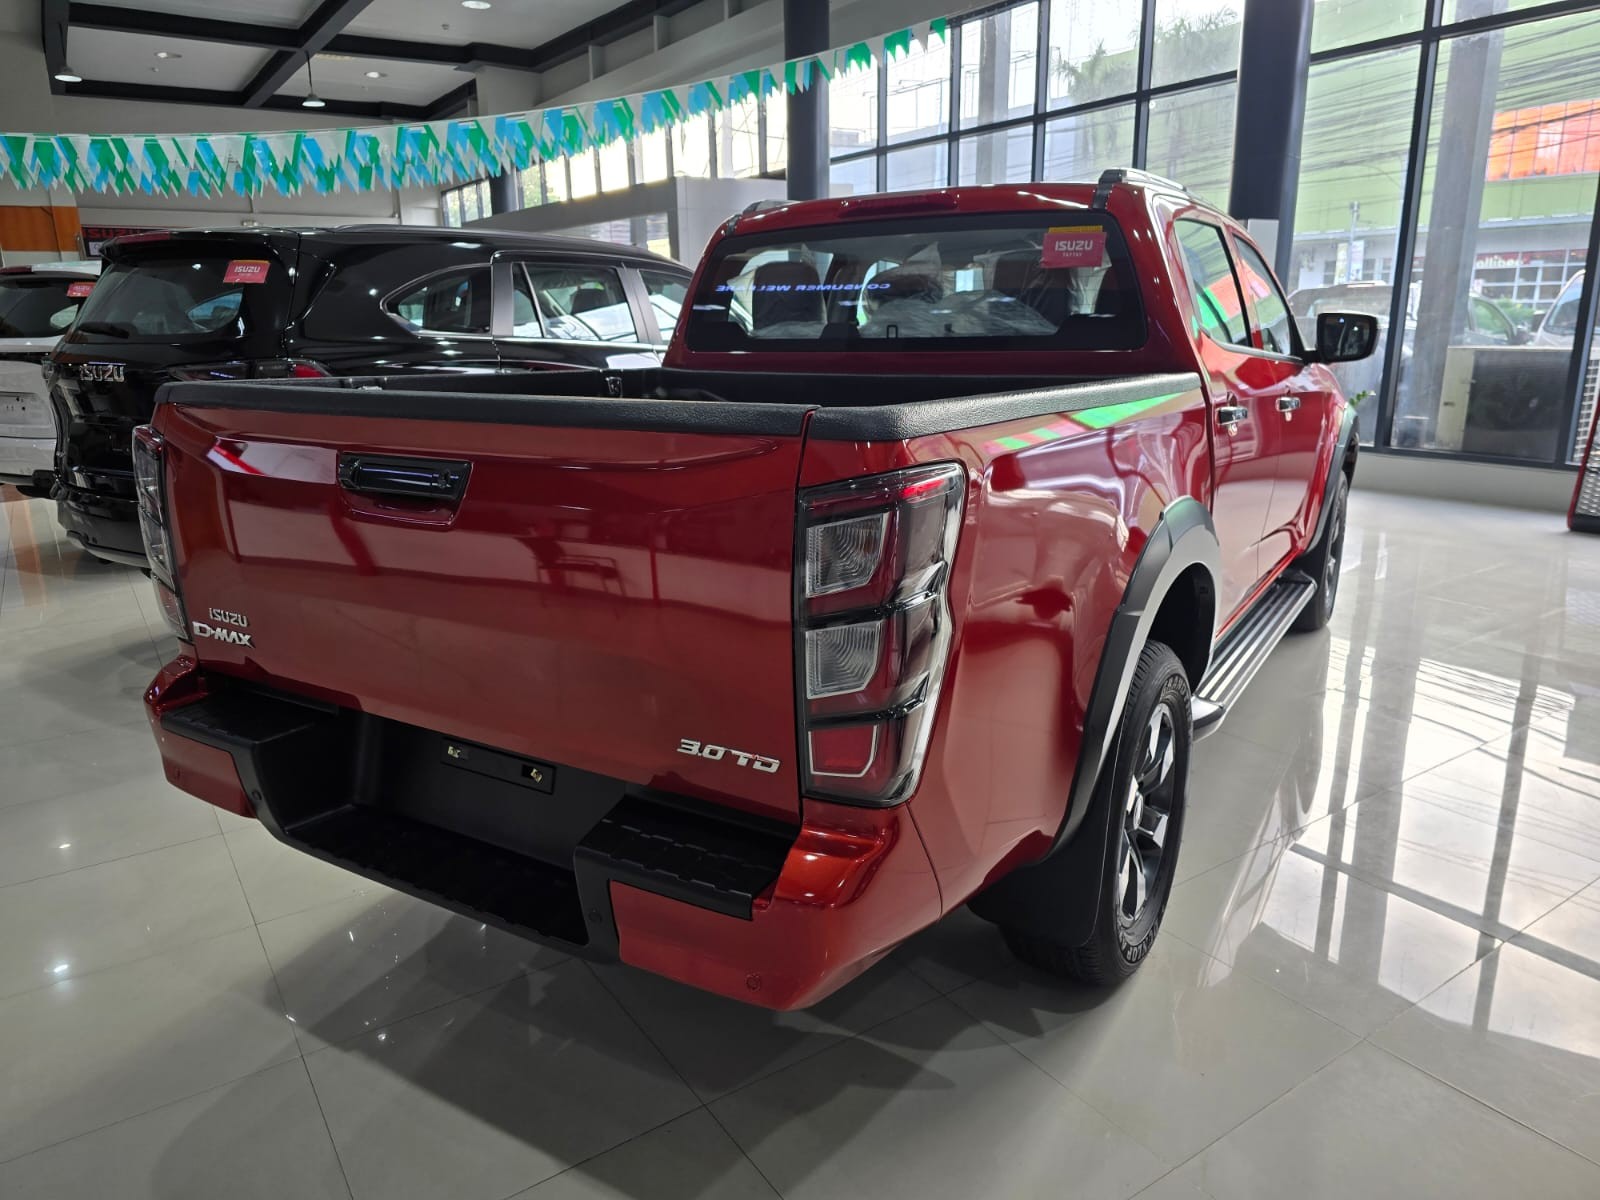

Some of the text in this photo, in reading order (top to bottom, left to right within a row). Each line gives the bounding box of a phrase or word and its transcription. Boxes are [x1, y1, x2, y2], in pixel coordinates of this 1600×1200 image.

[1055, 240, 1093, 251] ISUZU
[234, 265, 261, 273] ISUZU
[1476, 254, 1524, 269] ollibee
[80, 364, 125, 383] ISUZU
[209, 607, 248, 628] ISUZU
[192, 621, 255, 649] D-MAX
